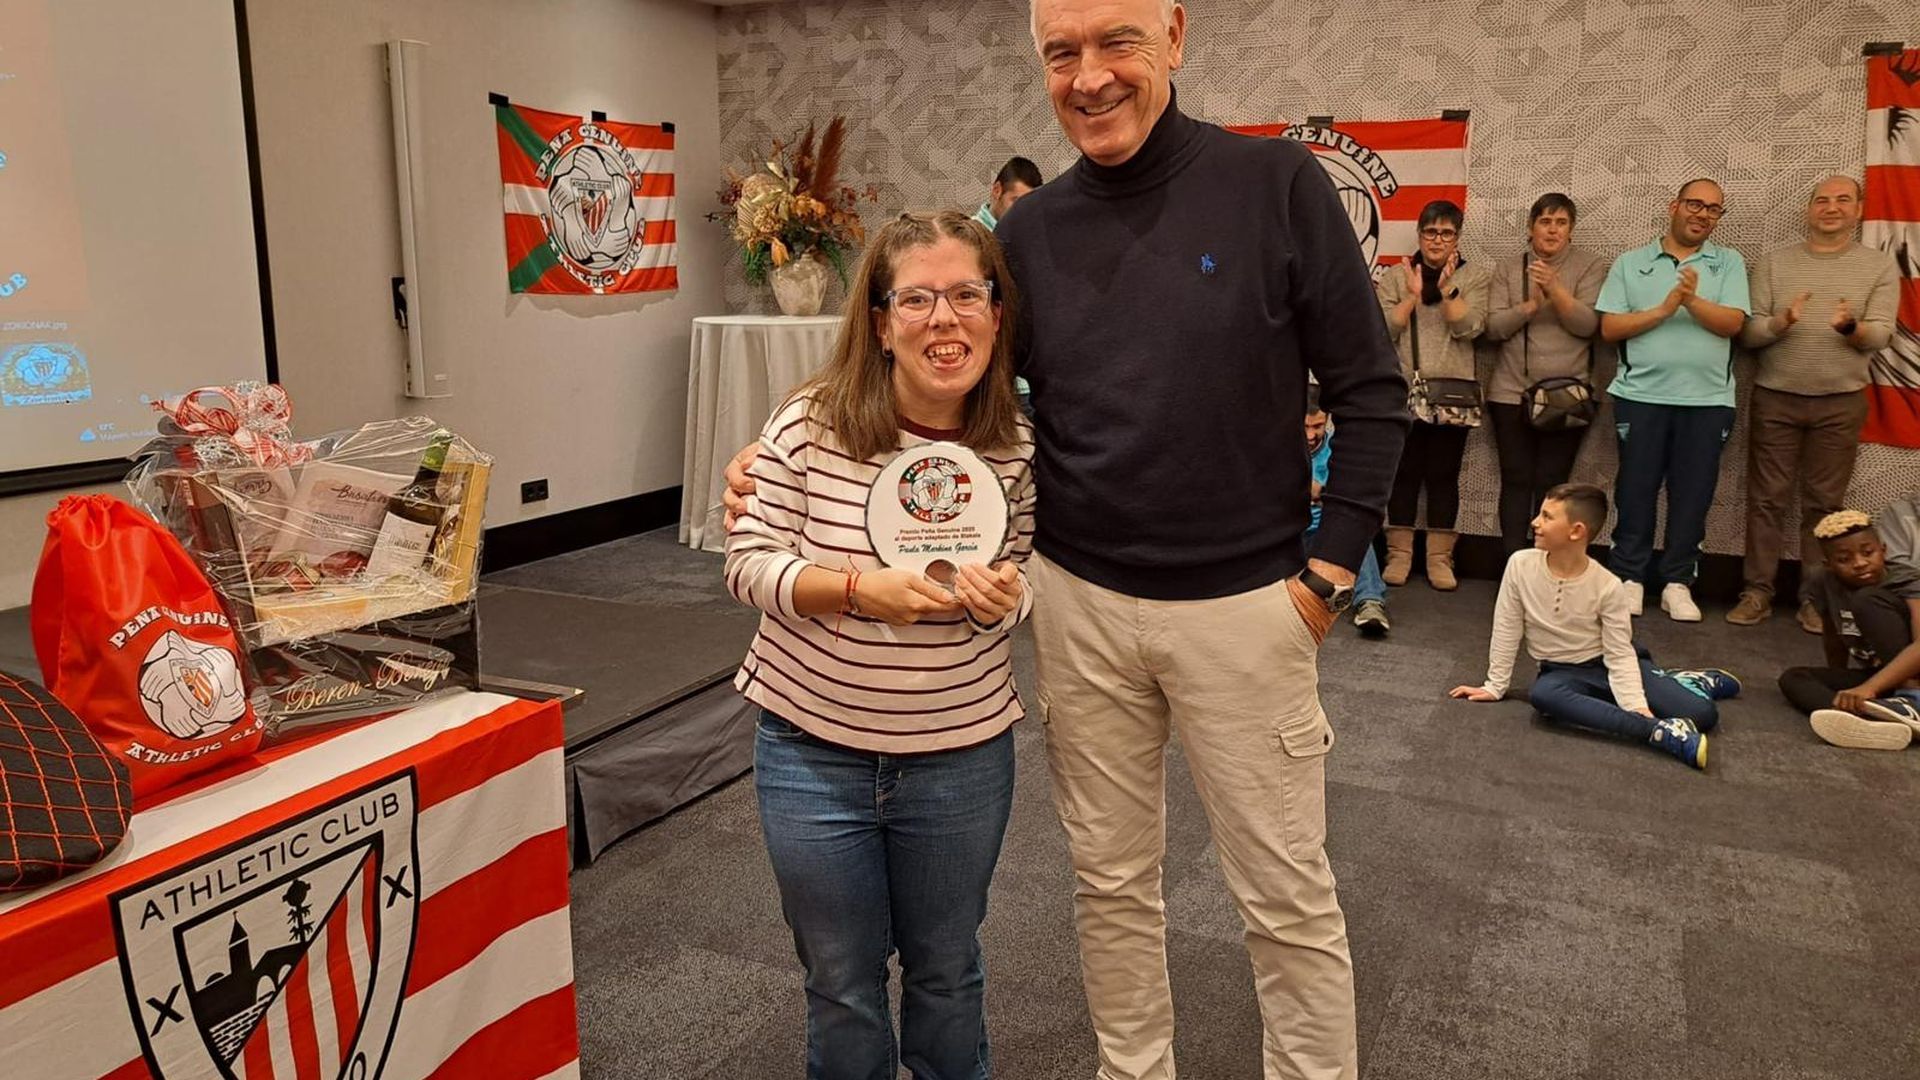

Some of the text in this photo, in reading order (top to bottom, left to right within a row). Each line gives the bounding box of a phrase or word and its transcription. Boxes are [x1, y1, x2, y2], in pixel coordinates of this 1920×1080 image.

[125, 742, 223, 765] ATHLETIC
[139, 792, 400, 931] ATHLETIC CLUB
